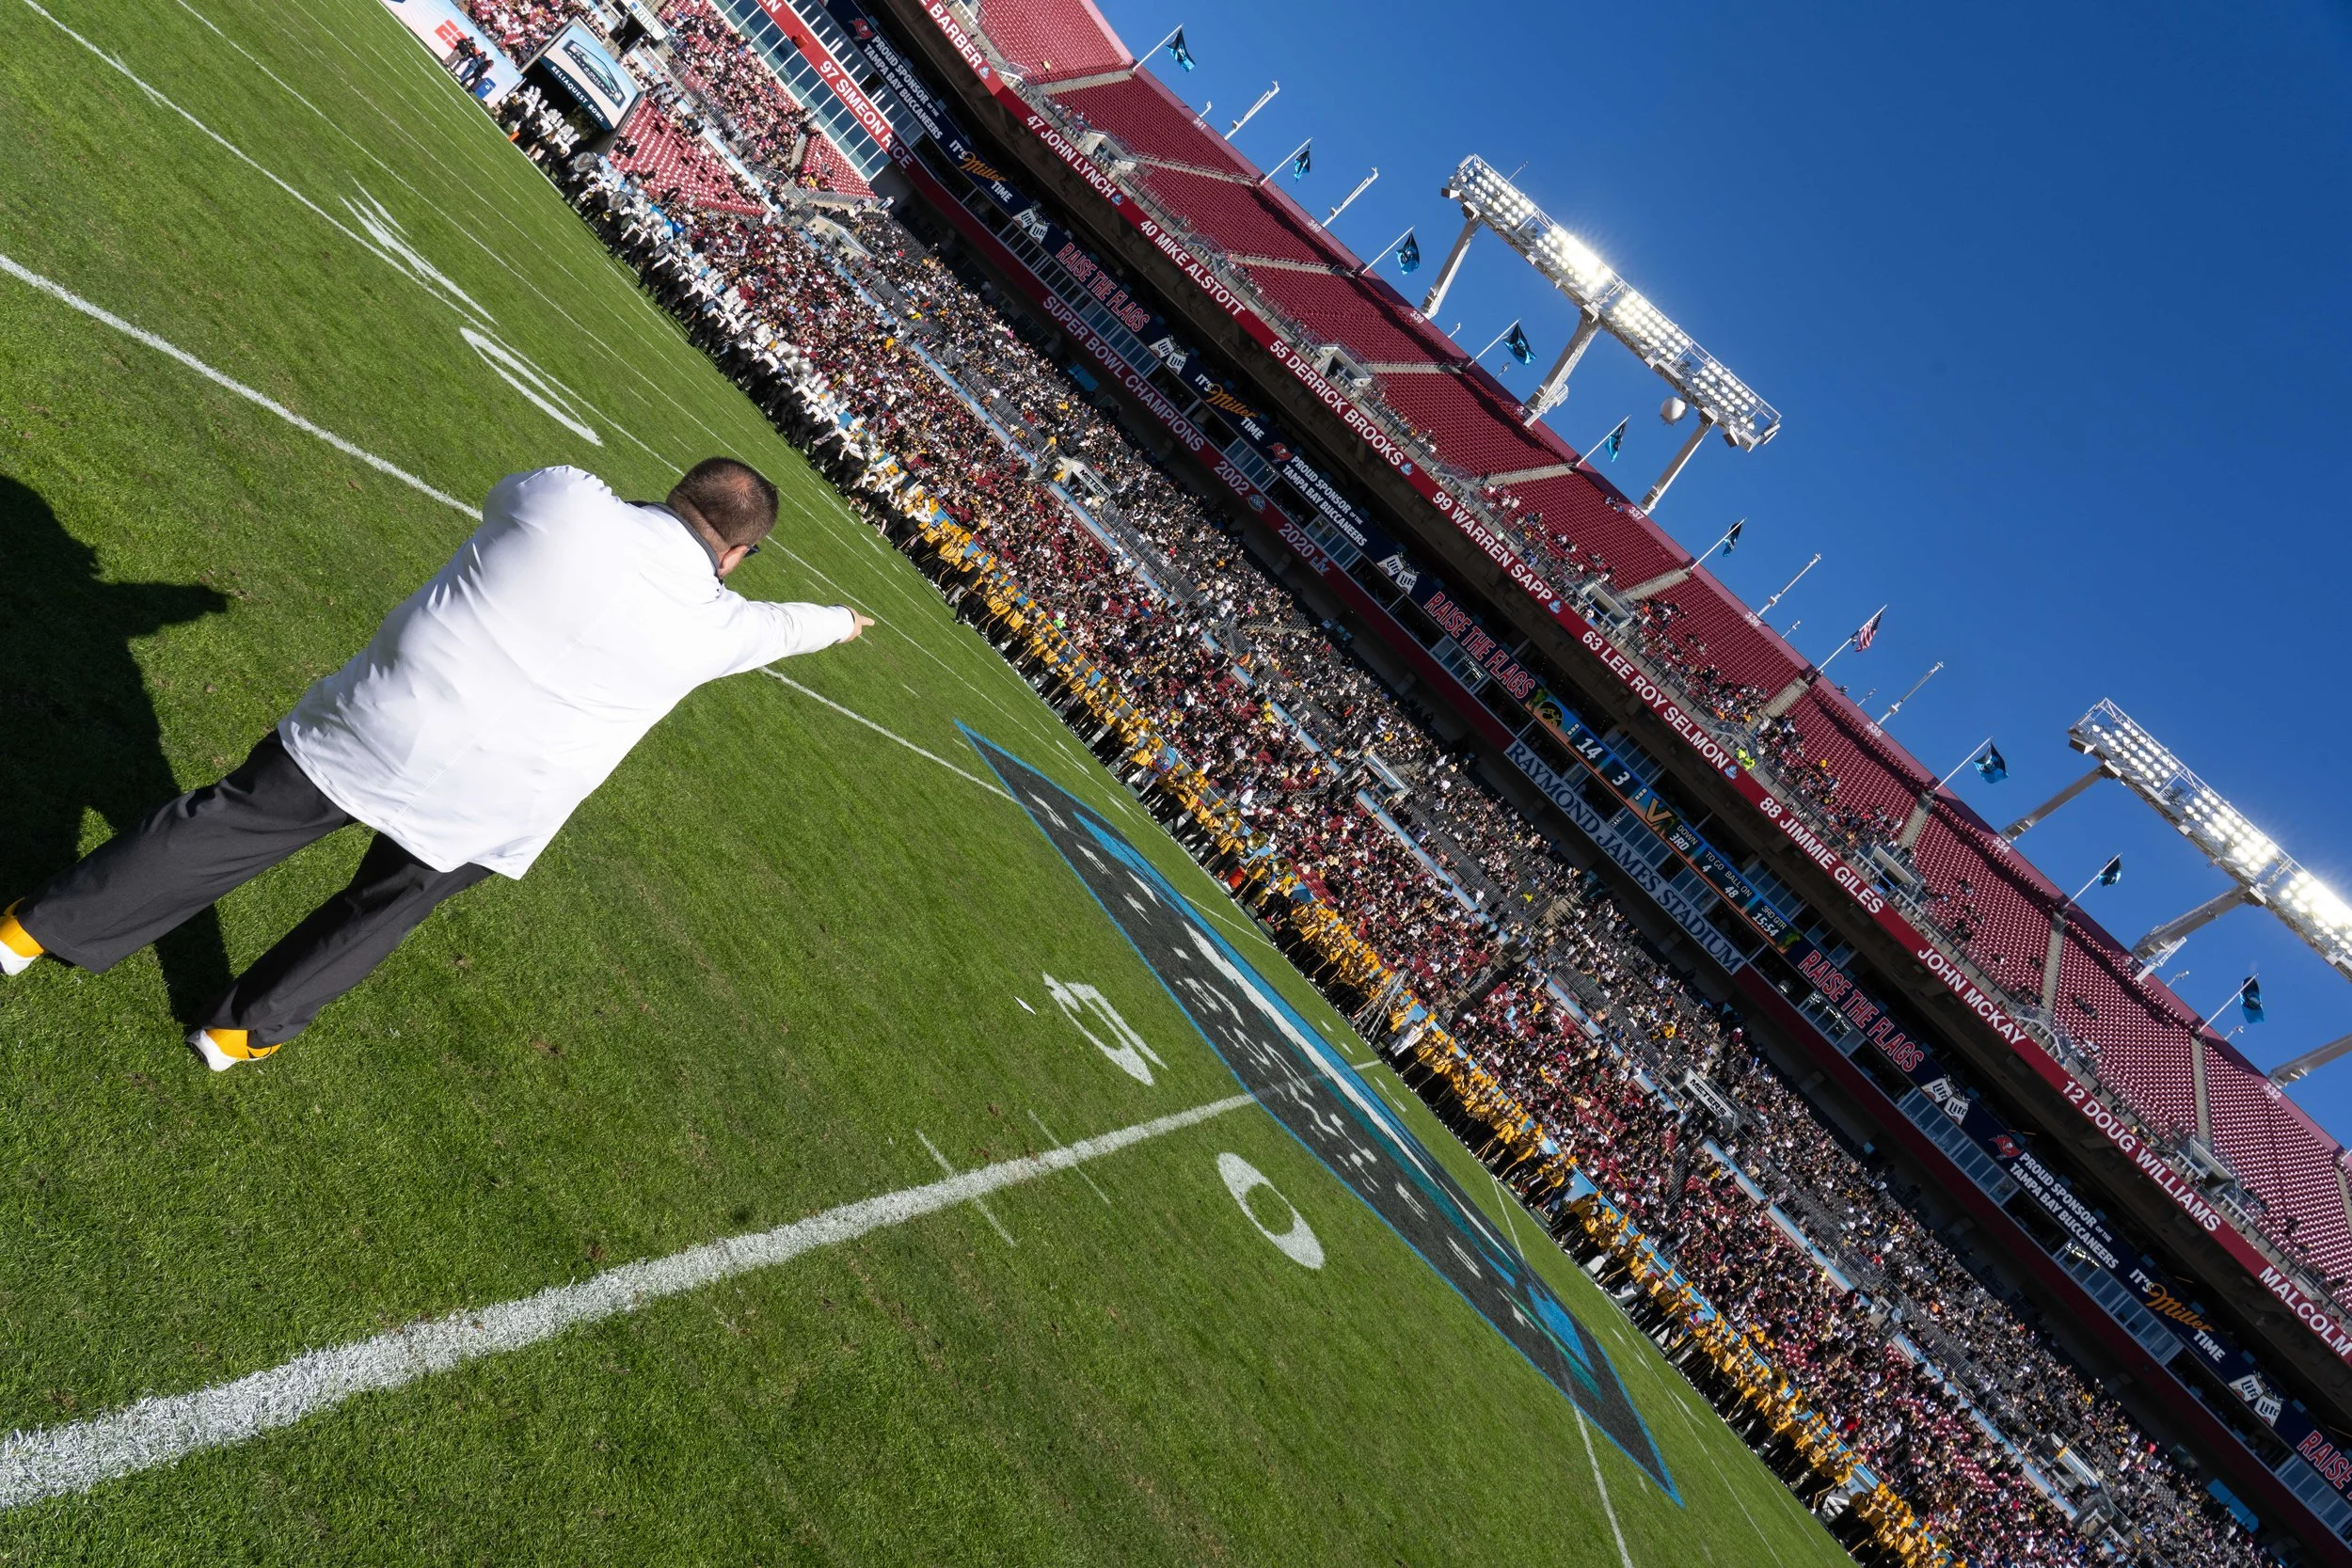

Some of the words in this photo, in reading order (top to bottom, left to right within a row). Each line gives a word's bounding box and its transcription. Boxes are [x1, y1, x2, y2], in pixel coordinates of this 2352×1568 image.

[929, 2, 984, 68] BARBER
[550, 65, 588, 103] RELIAQUEST
[587, 103, 604, 121] BOWL
[863, 44, 889, 75] TAMPA
[885, 71, 903, 91] BAY
[898, 87, 943, 139] BUCCANEERS
[871, 35, 899, 67] PROUD
[895, 62, 930, 104] SPONSOR
[818, 59, 839, 79] 97
[834, 78, 885, 135] SIMEON
[880, 133, 914, 168] RICE
[1193, 117, 1206, 130] 341
[960, 153, 1007, 182] Miller
[991, 181, 1012, 202] TIME
[1025, 114, 1044, 131] 47
[1039, 128, 1077, 164] JOHN
[1072, 157, 1116, 198] LYNCH
[1308, 218, 1322, 231] 340
[1055, 242, 1097, 283] RAISE
[1087, 269, 1118, 302] THE
[1105, 289, 1152, 334] FLAGS
[1138, 218, 1158, 238] 40
[1153, 232, 1189, 267] MIKE
[1184, 261, 1246, 317] ALSTOTT
[1409, 309, 1424, 324] 339
[1041, 295, 1089, 341] SUPER
[1084, 336, 1128, 378] BOWL
[1122, 372, 1205, 452] CHAMPIONS
[1205, 386, 1258, 418] Miller
[1240, 417, 1264, 440] TIME
[1269, 340, 1290, 359] 55
[1285, 355, 1348, 414] DERRICK
[1343, 407, 1406, 467] BROOKS
[1213, 459, 1250, 497] 2002
[1281, 464, 1309, 492] TAMPA
[1305, 486, 1325, 505] BAY
[1319, 500, 1368, 546] BUCCANEERS
[1290, 454, 1319, 483] PROUD
[1313, 478, 1352, 514] SPONSOR
[1354, 515, 1363, 525] THE
[1278, 522, 1315, 559] 2020
[1628, 505, 1644, 520] 337
[1431, 490, 1454, 512] 99
[1451, 506, 1514, 567] WARREN
[1509, 562, 1552, 604] SAPP
[1423, 591, 1472, 639] RAISE
[1461, 625, 1496, 661] THE
[1484, 648, 1536, 701] FLAGS
[1744, 610, 1761, 626] 336
[1581, 629, 1604, 652] 63
[1598, 646, 1633, 679] LEE
[1629, 674, 1667, 708] ROY
[1661, 705, 1729, 770] SELMON
[1866, 721, 1883, 736] 335
[1575, 736, 1603, 762] 14
[1611, 769, 1630, 788] 3
[1505, 741, 1602, 836] RAYMOND
[1594, 833, 1661, 895] JAMES
[1656, 887, 1744, 974] STADIUM
[1668, 832, 1689, 851] 3RD
[1677, 824, 1698, 845] DOWN
[1706, 850, 1715, 863] TO
[1712, 859, 1724, 870] GO
[1757, 796, 1783, 819] 88
[1777, 816, 1836, 870] JIMMIE
[1831, 863, 1885, 916] GILES
[1992, 836, 2010, 853] 334
[1702, 864, 1710, 873] 4
[1723, 884, 1739, 899] 48
[1724, 870, 1741, 888] BALL
[1740, 885, 1752, 897] ON
[1752, 912, 1779, 938] 15:54
[1772, 916, 1787, 929] QTR
[1797, 948, 1852, 1004] RAISE
[1840, 989, 1880, 1030] THE
[1866, 1015, 1926, 1074] FLAGS
[1915, 946, 1968, 994] JOHN
[1962, 986, 2027, 1046] MCKAY
[1690, 1078, 1726, 1115] METERS
[2262, 1081, 2281, 1100] 332
[2060, 1080, 2086, 1104] 12
[2081, 1099, 2137, 1153] DOUG
[2135, 1148, 2222, 1233] WILLIAMS
[2009, 1163, 2043, 1197] TAMPA
[2039, 1192, 2062, 1213] BAY
[2057, 1210, 2120, 1269] BUCCANEERS
[2018, 1151, 2056, 1187] PROUD
[2049, 1182, 2098, 1227] SPONSOR
[2094, 1226, 2104, 1234] OF
[2100, 1231, 2112, 1243] THE
[2145, 1284, 2216, 1331] Miller
[2192, 1330, 2226, 1362] TIME
[2258, 1265, 2351, 1356] MALCOLM
[2296, 1429, 2352, 1490] RAISE
